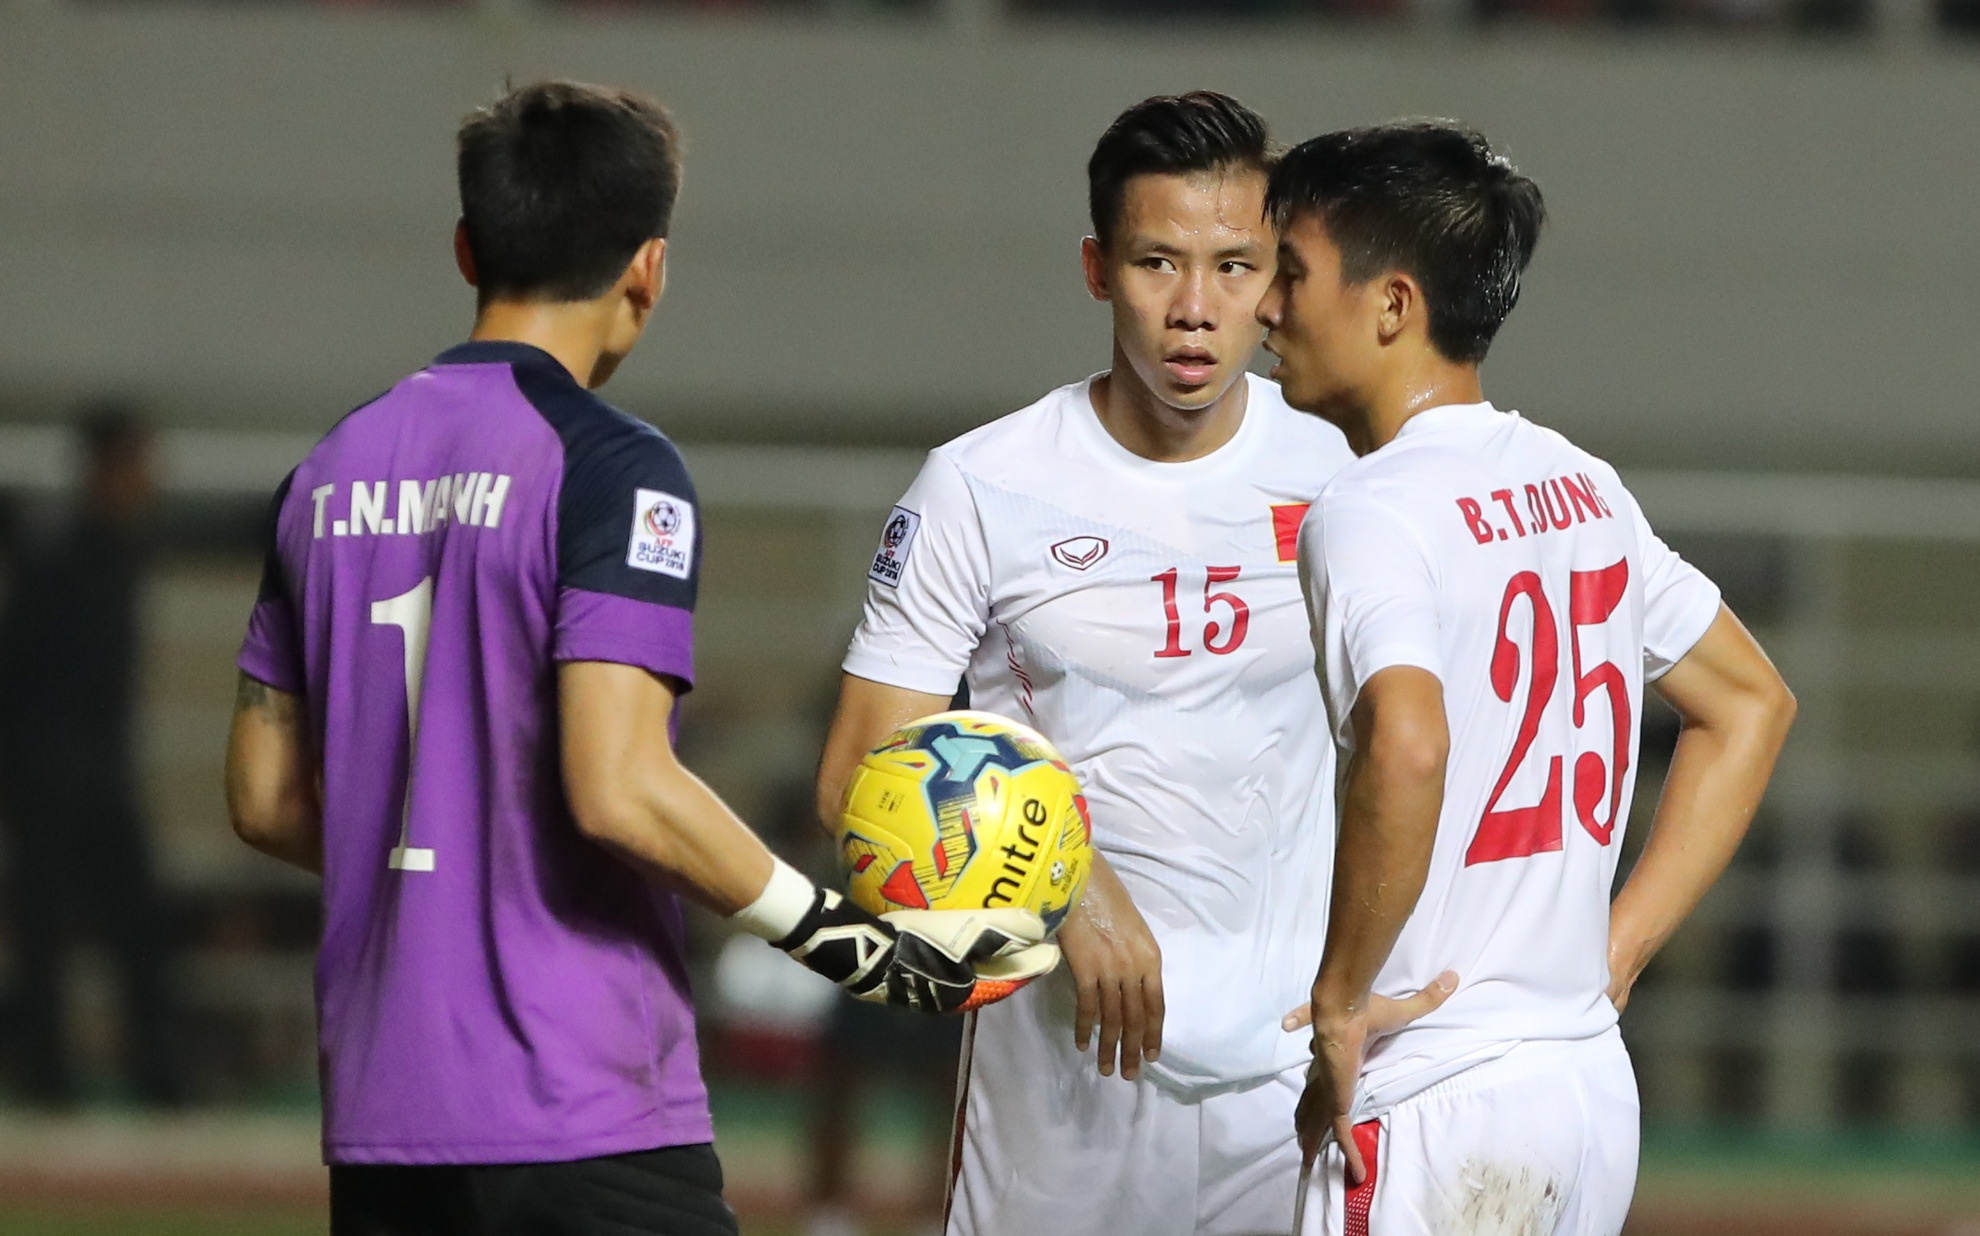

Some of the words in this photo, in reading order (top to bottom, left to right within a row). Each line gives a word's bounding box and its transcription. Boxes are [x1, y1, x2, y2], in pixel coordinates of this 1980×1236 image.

[636, 551, 664, 565] CUP
[638, 541, 686, 562] SUZUKI
[1151, 565, 1250, 657] 15
[370, 575, 435, 871] 1
[1465, 555, 1631, 868] 25
[982, 799, 1047, 908] mitre
